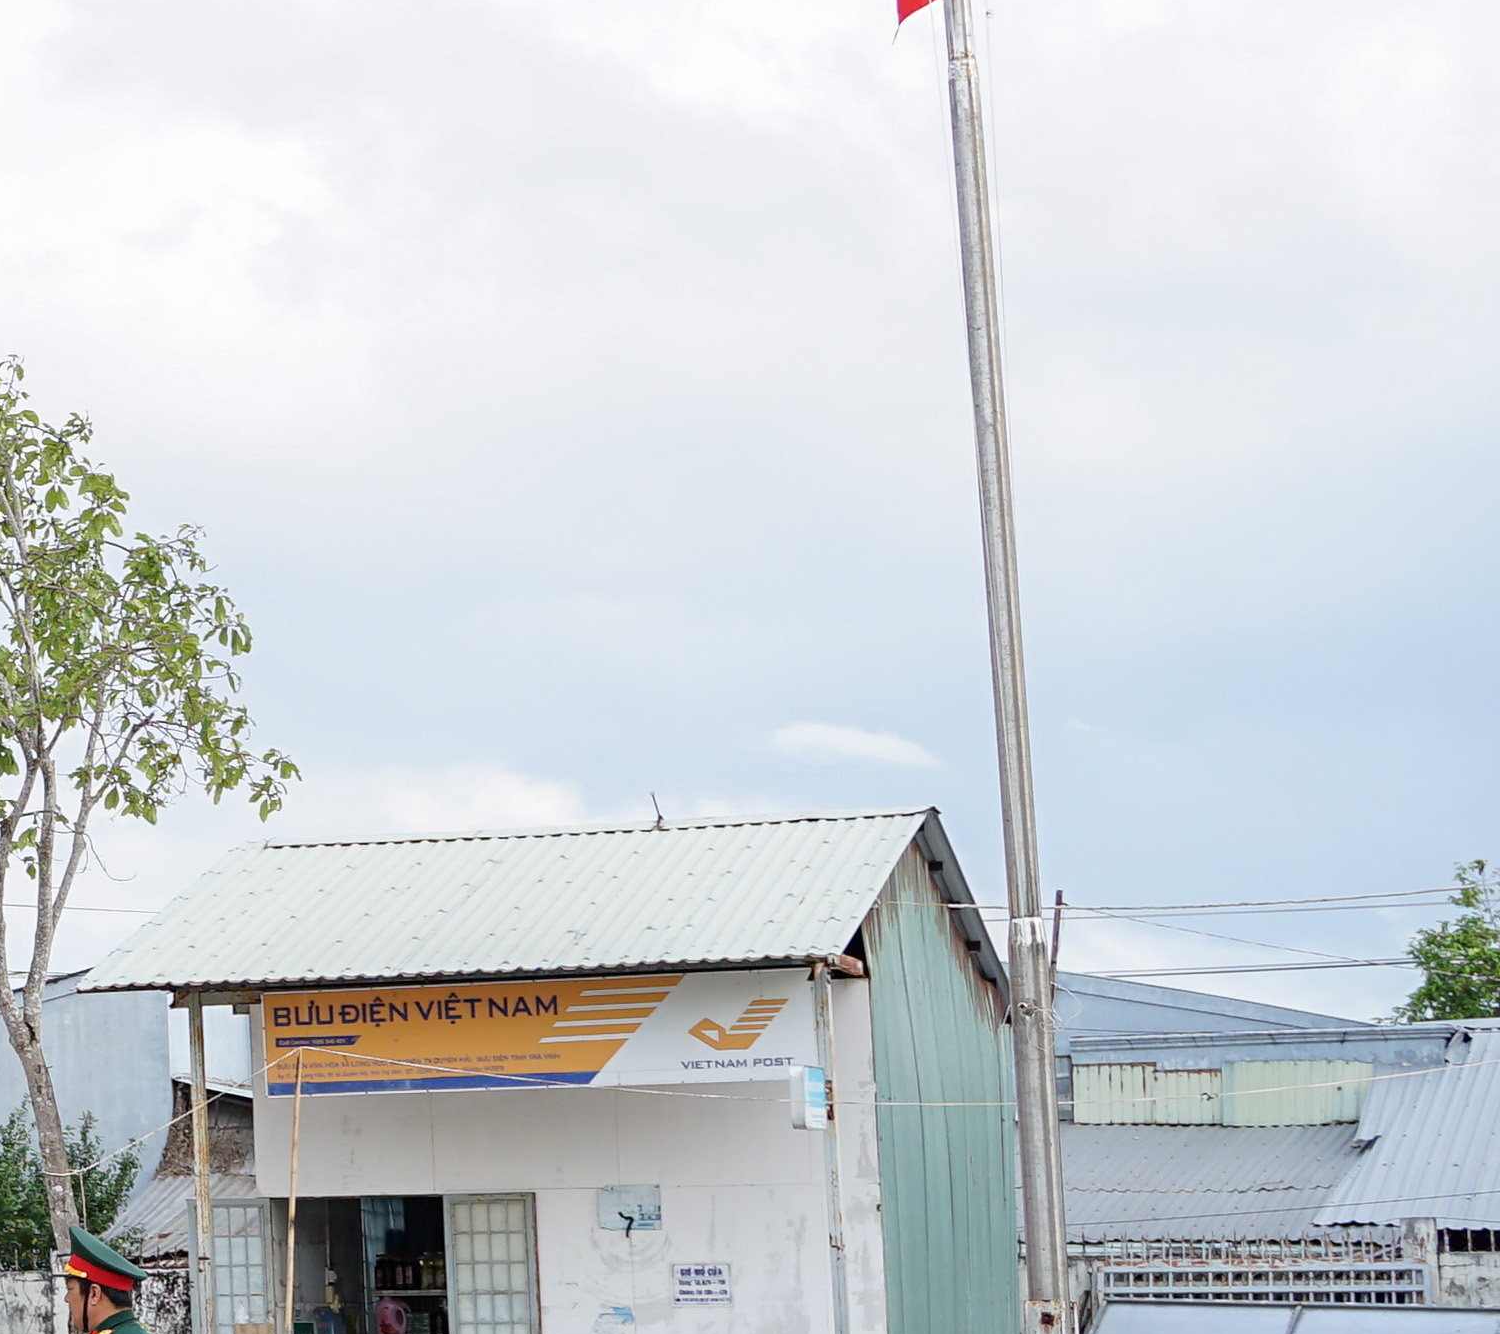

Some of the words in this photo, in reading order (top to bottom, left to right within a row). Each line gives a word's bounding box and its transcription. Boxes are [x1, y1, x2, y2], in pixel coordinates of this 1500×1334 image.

[274, 1000, 334, 1027] BƯU
[338, 996, 409, 1027] ĐIỆN
[414, 992, 482, 1024] VIỆT
[489, 995, 558, 1018] NAM
[681, 1059, 748, 1070] VIETNAM
[753, 1057, 794, 1067] POST
